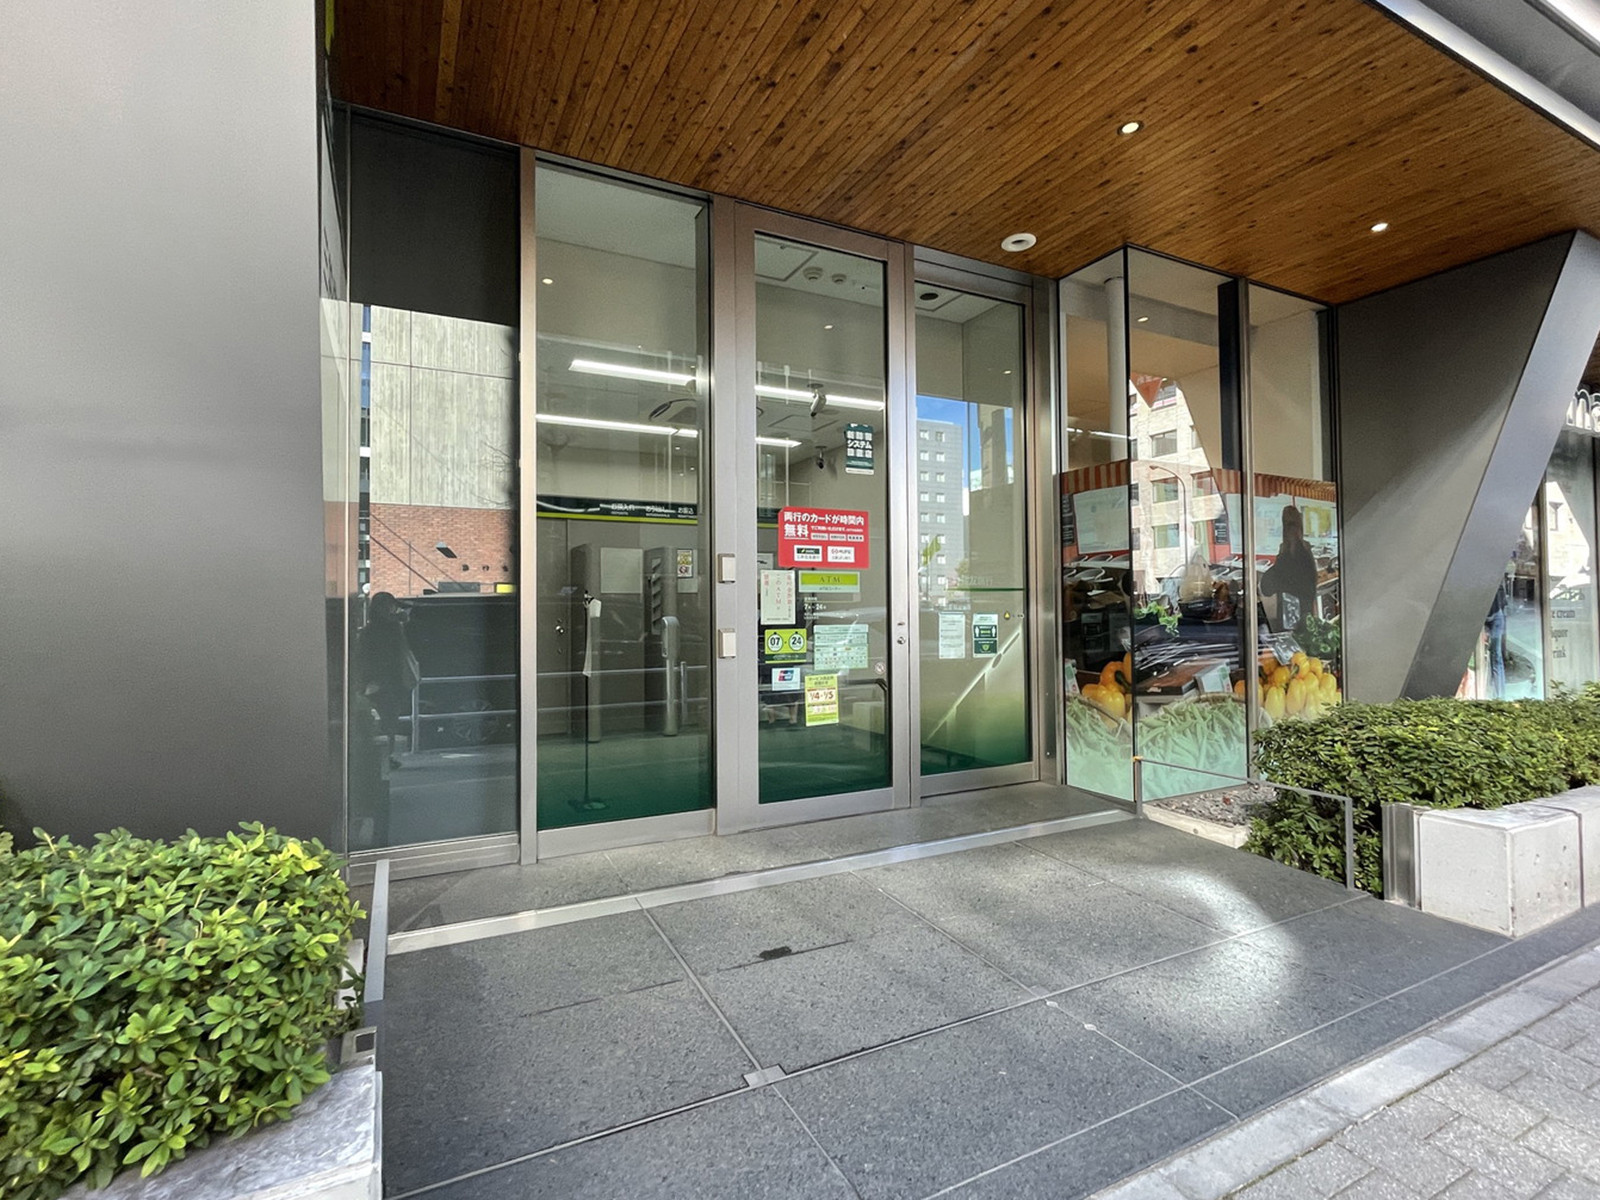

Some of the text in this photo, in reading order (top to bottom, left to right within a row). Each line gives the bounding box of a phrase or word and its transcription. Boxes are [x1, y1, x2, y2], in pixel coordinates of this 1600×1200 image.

[847, 439, 873, 450] システム
[784, 523, 809, 538] 無料
[819, 575, 842, 583] ATM
[769, 636, 802, 646] 07 24
